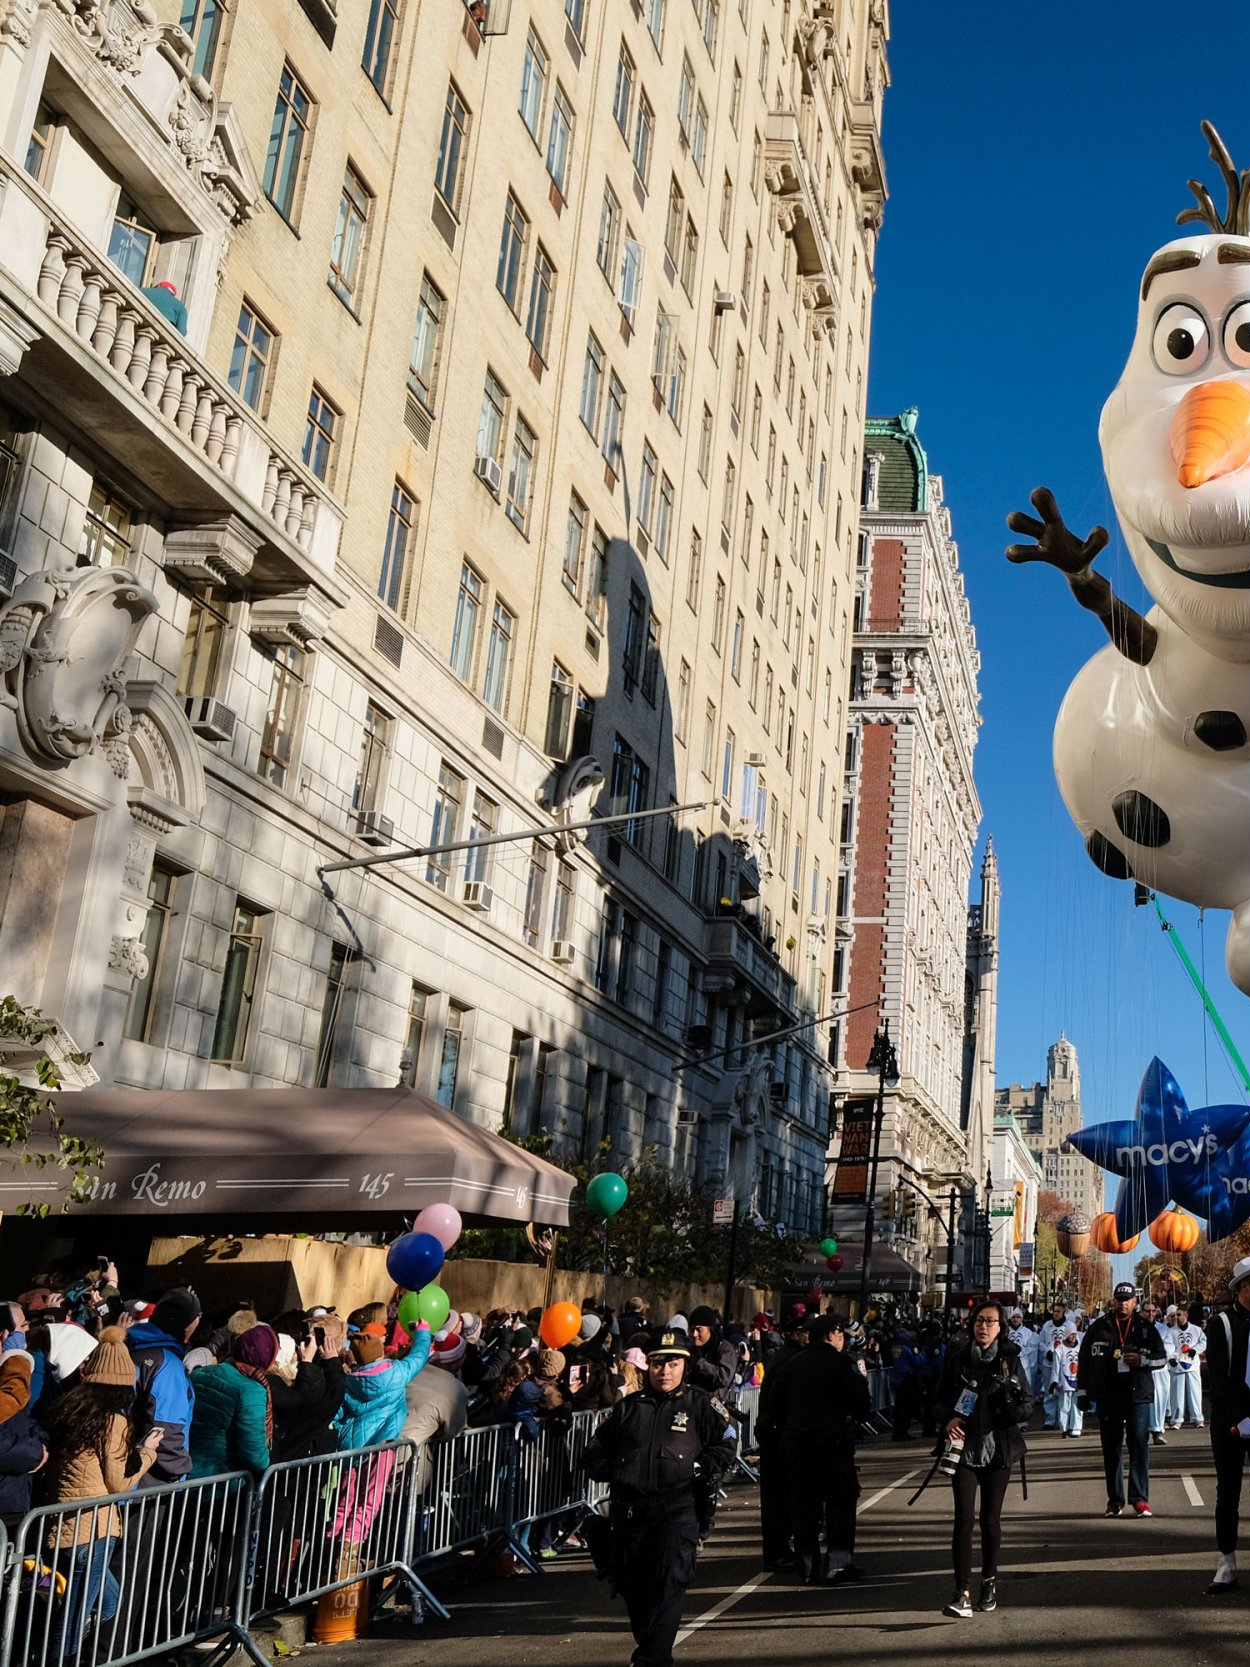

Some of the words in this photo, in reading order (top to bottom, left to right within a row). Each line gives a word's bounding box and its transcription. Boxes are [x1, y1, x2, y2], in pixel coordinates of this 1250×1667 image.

[844, 1120, 871, 1132] VIET
[843, 1132, 869, 1143] NAM
[842, 1143, 868, 1155] WAR
[78, 1176, 117, 1200] an
[131, 1163, 207, 1207] Remo
[359, 1173, 395, 1200] 145
[334, 1591, 359, 1608] DO
